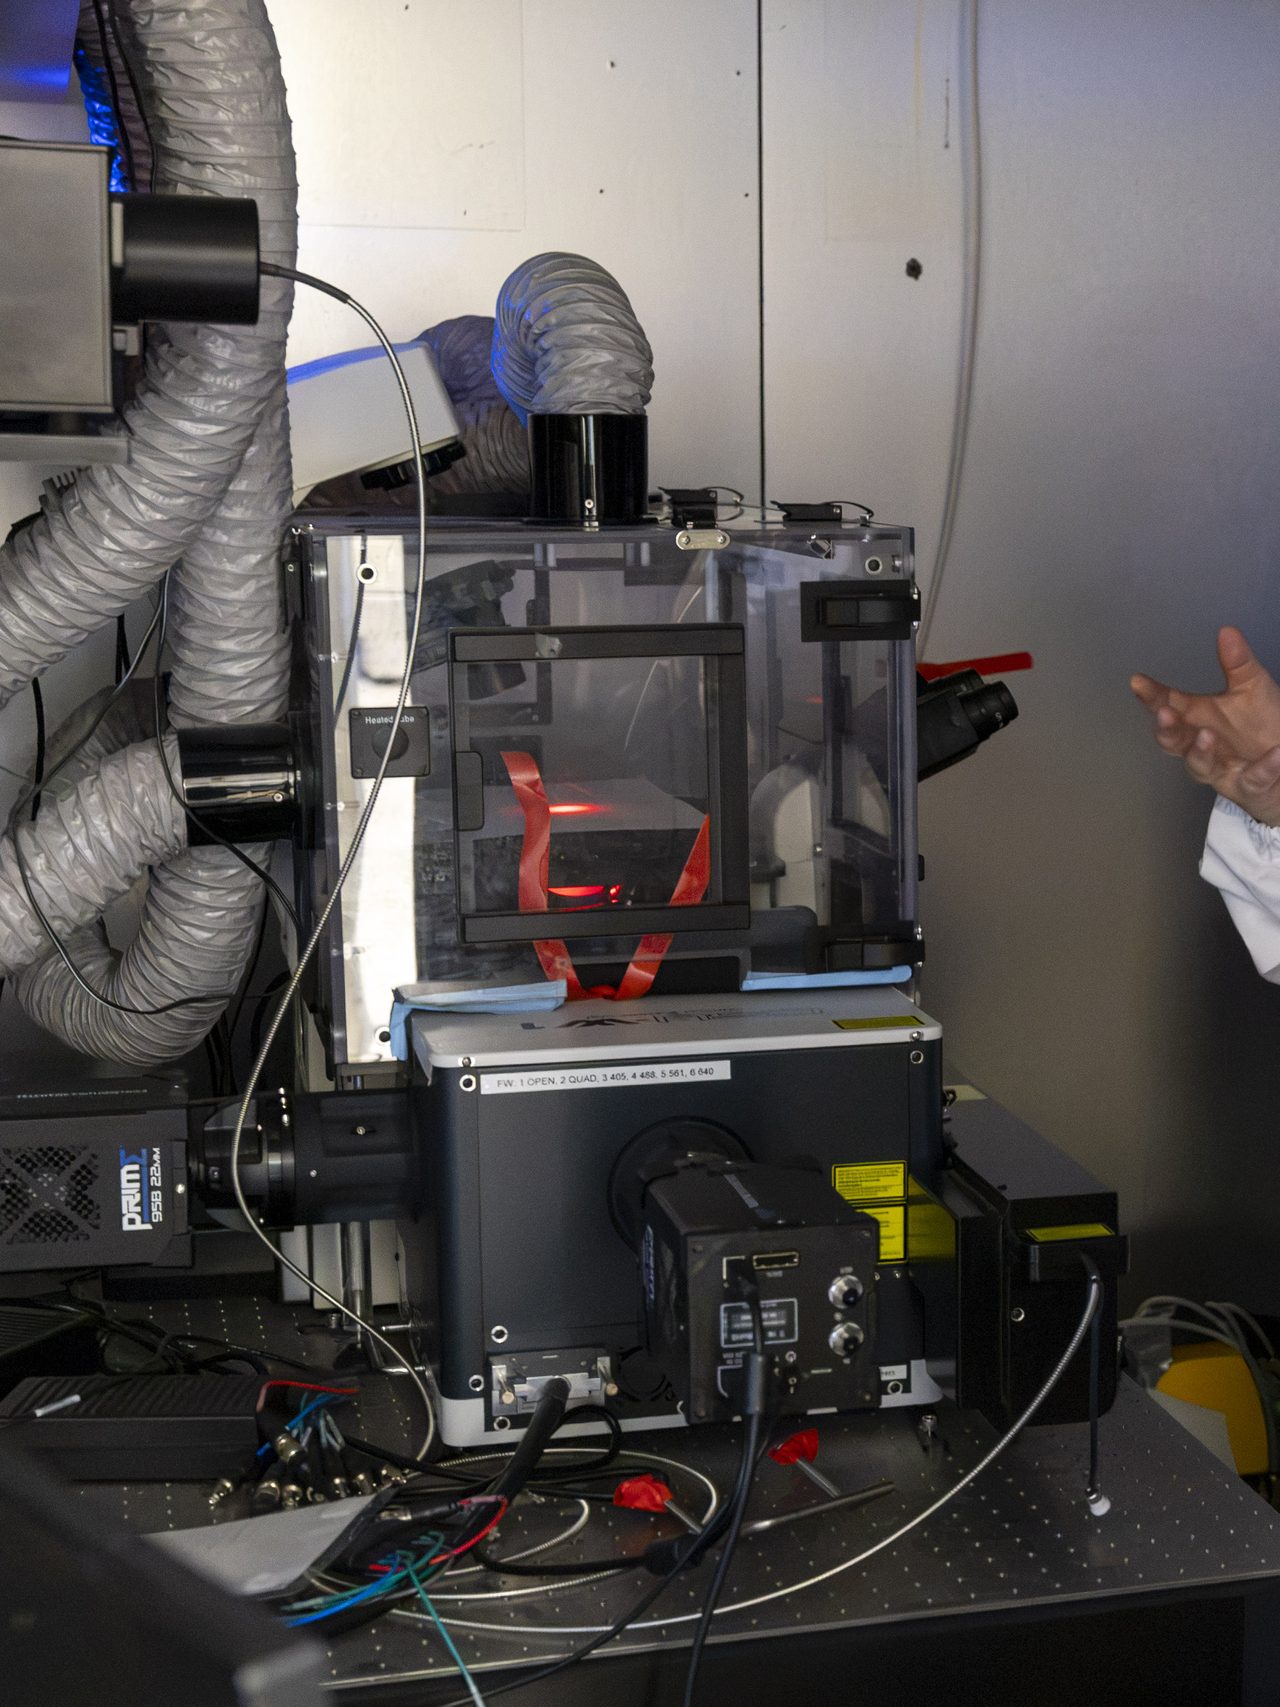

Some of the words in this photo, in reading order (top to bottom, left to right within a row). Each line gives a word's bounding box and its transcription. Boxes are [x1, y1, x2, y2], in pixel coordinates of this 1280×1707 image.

[365, 715, 394, 724] Heated
[560, 1076, 566, 1085] 2
[602, 1073, 608, 1082] 3
[631, 1072, 637, 1080] 4
[660, 1069, 667, 1078] 5
[690, 1068, 696, 1076] 6
[151, 1190, 163, 1223] 95B
